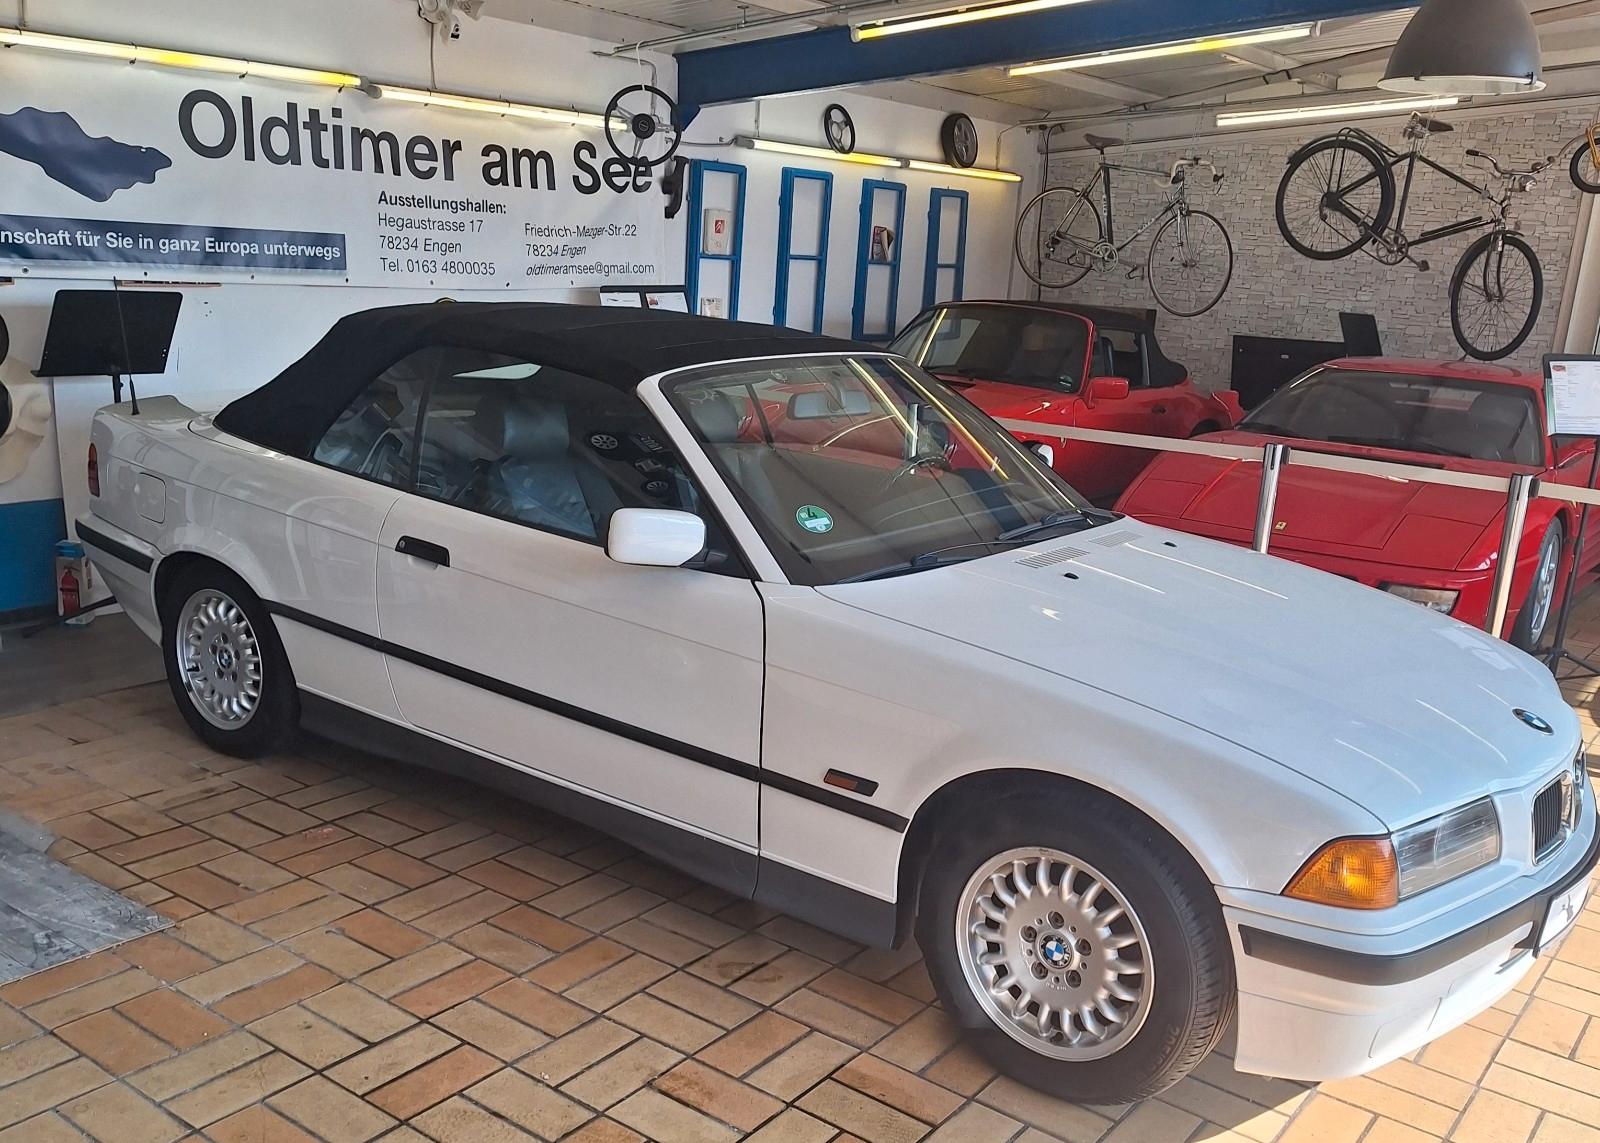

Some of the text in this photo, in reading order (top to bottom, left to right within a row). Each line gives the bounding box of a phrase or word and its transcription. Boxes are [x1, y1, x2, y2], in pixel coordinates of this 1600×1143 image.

[178, 89, 653, 195] Oldtimer am See
[378, 190, 507, 214] Ausstellungshallen:
[378, 212, 484, 232] Hegaustrasse 17
[524, 222, 638, 239] Friedrich-Mezger-Str.22
[75, 230, 101, 248] für
[105, 232, 134, 249] Sie
[138, 234, 154, 249] in
[159, 237, 200, 253] ganz
[205, 237, 260, 256] Europa
[263, 240, 341, 259] unterwegs
[379, 235, 462, 256] 78234 Engen
[525, 243, 587, 258] 78234 Engen
[379, 257, 496, 276] Tel. 0163 4800035
[526, 261, 655, 277] oldtimeramsee@gmail.com
